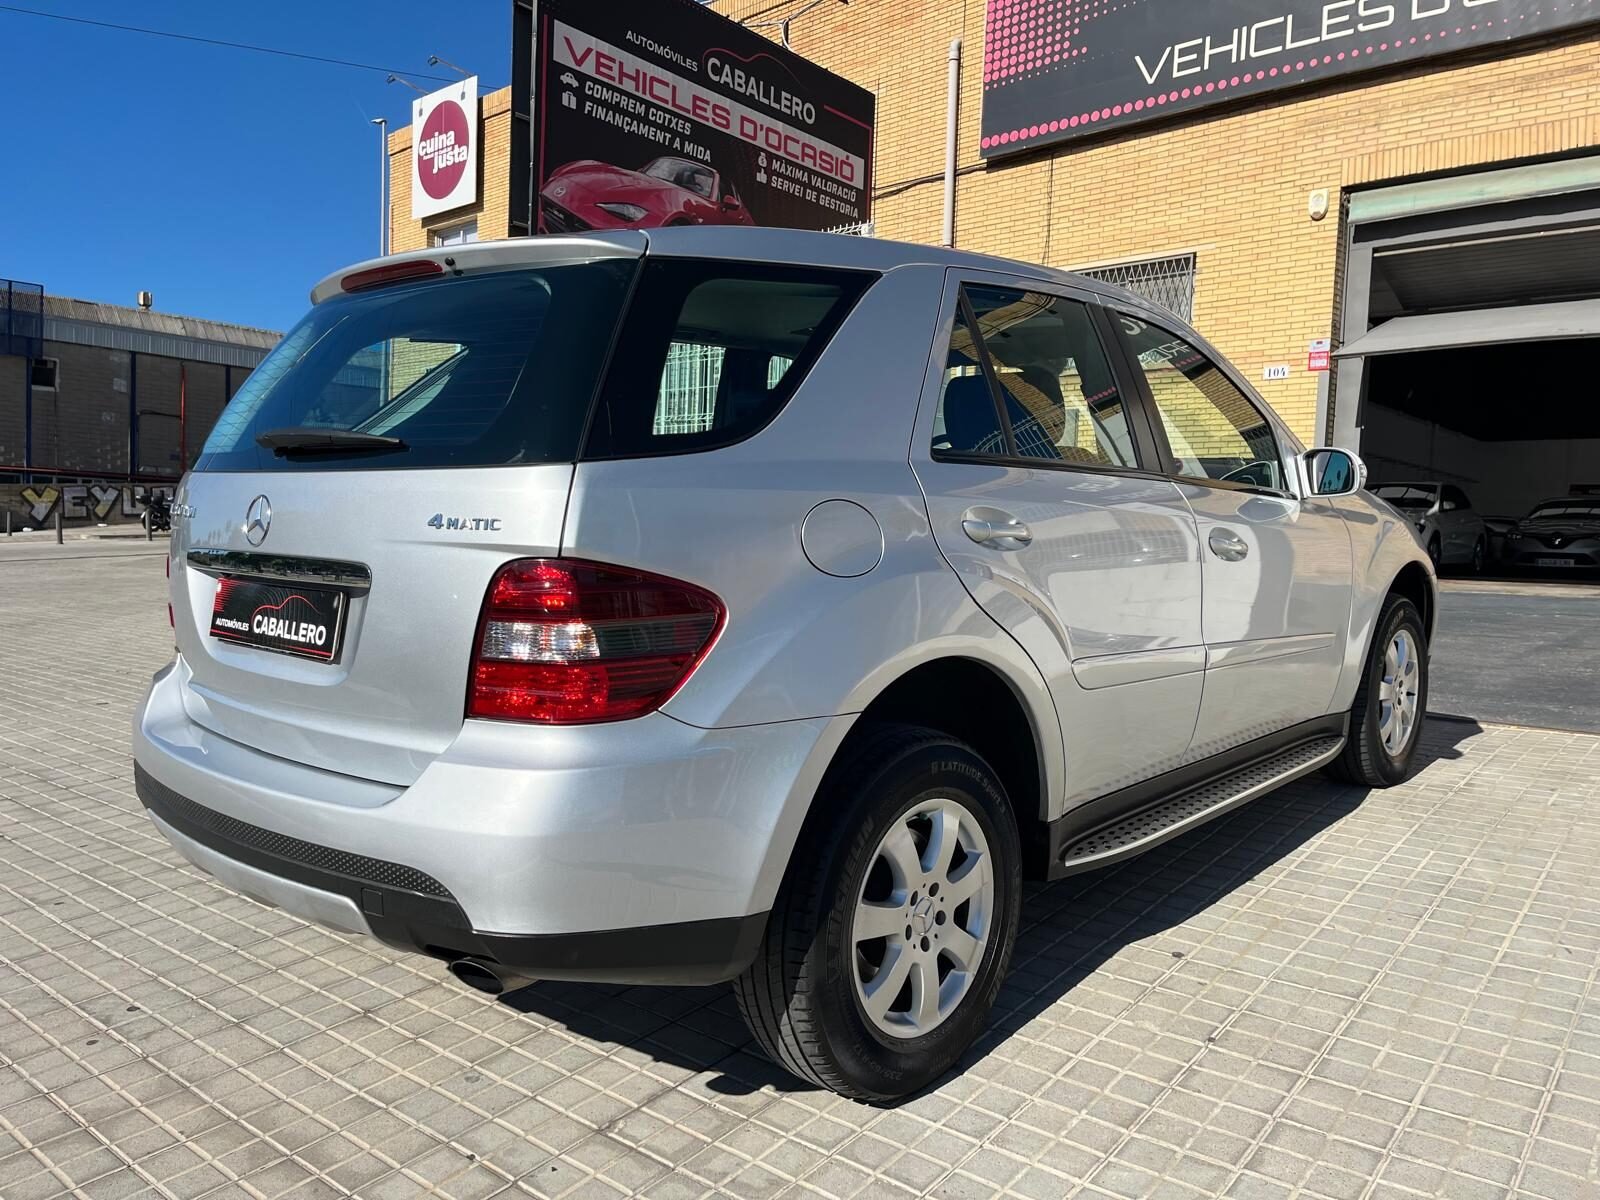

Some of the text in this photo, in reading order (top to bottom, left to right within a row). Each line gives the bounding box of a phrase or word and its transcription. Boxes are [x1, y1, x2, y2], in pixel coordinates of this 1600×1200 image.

[625, 29, 699, 73] AUTOMÓVILES
[1134, 0, 1395, 85] VEHICLES
[563, 36, 855, 183] VEHICLES D'OCASIÓ
[585, 81, 692, 136] COMPREM COTXES
[707, 57, 816, 125] CABALLERO
[419, 130, 455, 156] cuina
[584, 103, 713, 163] FINANÇAMENT A MIDA
[433, 144, 468, 174] justa
[771, 158, 857, 203] MÀXIMA VALORACIÓ
[771, 175, 859, 219] SERVEI DE GESTORIA
[1268, 367, 1286, 378] 104
[215, 617, 250, 632] AUTOMÓVILES
[253, 614, 327, 646] CABALLERO
[941, 761, 982, 782] LATITUDE
